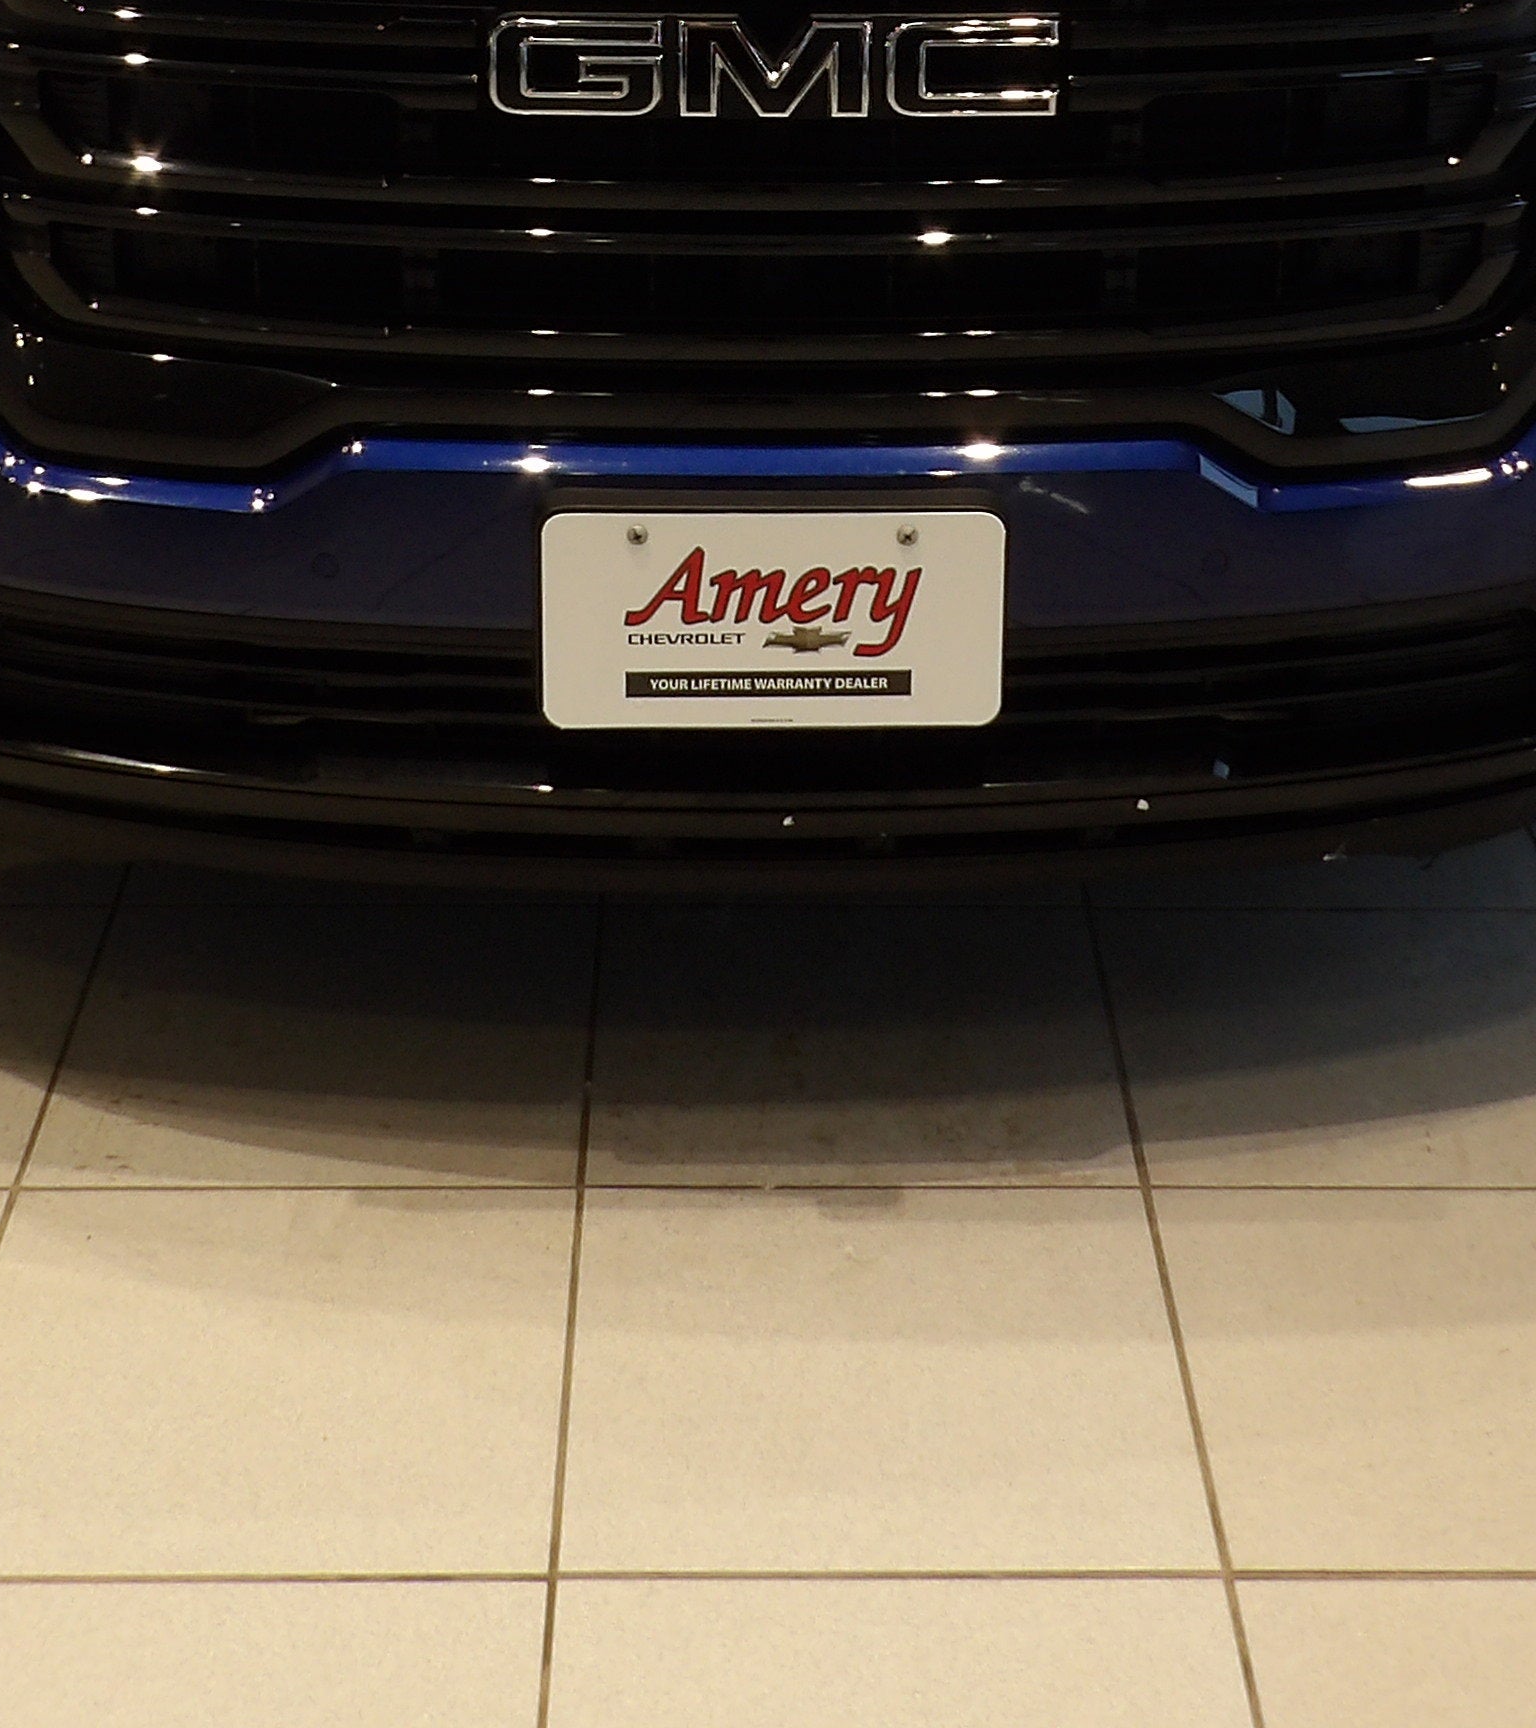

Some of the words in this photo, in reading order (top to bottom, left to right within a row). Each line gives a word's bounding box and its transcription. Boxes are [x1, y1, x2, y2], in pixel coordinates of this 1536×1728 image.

[490, 13, 1060, 117] GMC
[624, 546, 922, 657] Amery
[628, 633, 745, 645] CHEVROLET
[650, 679, 689, 690] YOUR
[691, 679, 752, 690] LIFETIME
[754, 678, 832, 689] WARRANTY
[835, 678, 888, 689] DEALER
